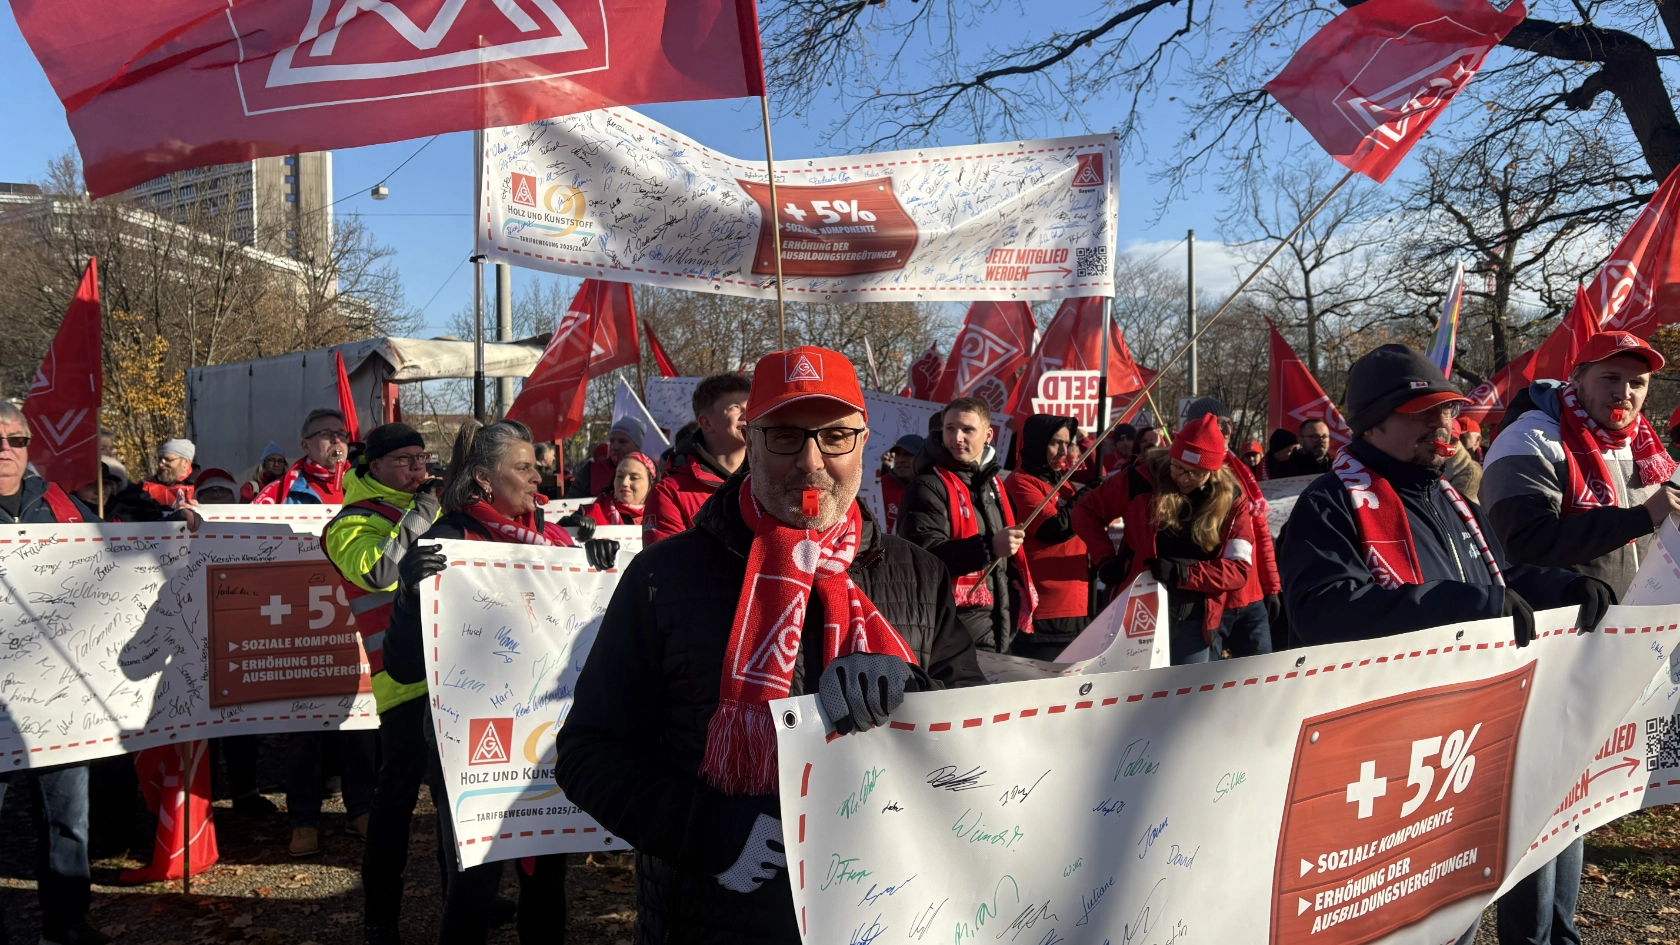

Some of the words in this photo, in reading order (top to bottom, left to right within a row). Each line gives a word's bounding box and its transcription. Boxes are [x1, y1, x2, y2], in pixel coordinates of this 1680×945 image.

[810, 199, 877, 224] 5%
[519, 235, 559, 249] TARIFBEWEGUNG
[560, 243, 582, 252] 2025/26
[781, 250, 897, 261] AUSBILDUNGSVERGÜTUNGEN
[782, 239, 831, 251] ERHÖHUNG
[832, 242, 850, 251] DER
[985, 248, 1015, 265] JETZT
[1015, 248, 1069, 265] MITGLIED
[985, 265, 1029, 282] WERDEN
[1043, 376, 1100, 400] GELD
[260, 595, 292, 625] +
[241, 637, 292, 651] SOZIALE
[294, 632, 361, 647] KOMPONEN
[241, 654, 308, 671] ERHÖHUNG
[310, 654, 334, 665] DER
[1114, 738, 1160, 782] Tobias
[1346, 760, 1387, 820] +
[1400, 722, 1483, 818] 5%
[460, 771, 489, 785] HOLZ
[492, 769, 519, 782] UND
[476, 808, 544, 822] TARIFBEWEGUNG
[1317, 840, 1378, 874] SOZIALE
[1378, 806, 1455, 854] KOMPONENTE
[1166, 844, 1200, 870] David
[1310, 847, 1478, 935] AUSBILDUNGSVERGÜTUNGEN
[1314, 868, 1386, 912] ERHÖHUNG
[1386, 857, 1411, 882] DER
[1075, 876, 1116, 926] Juliane
